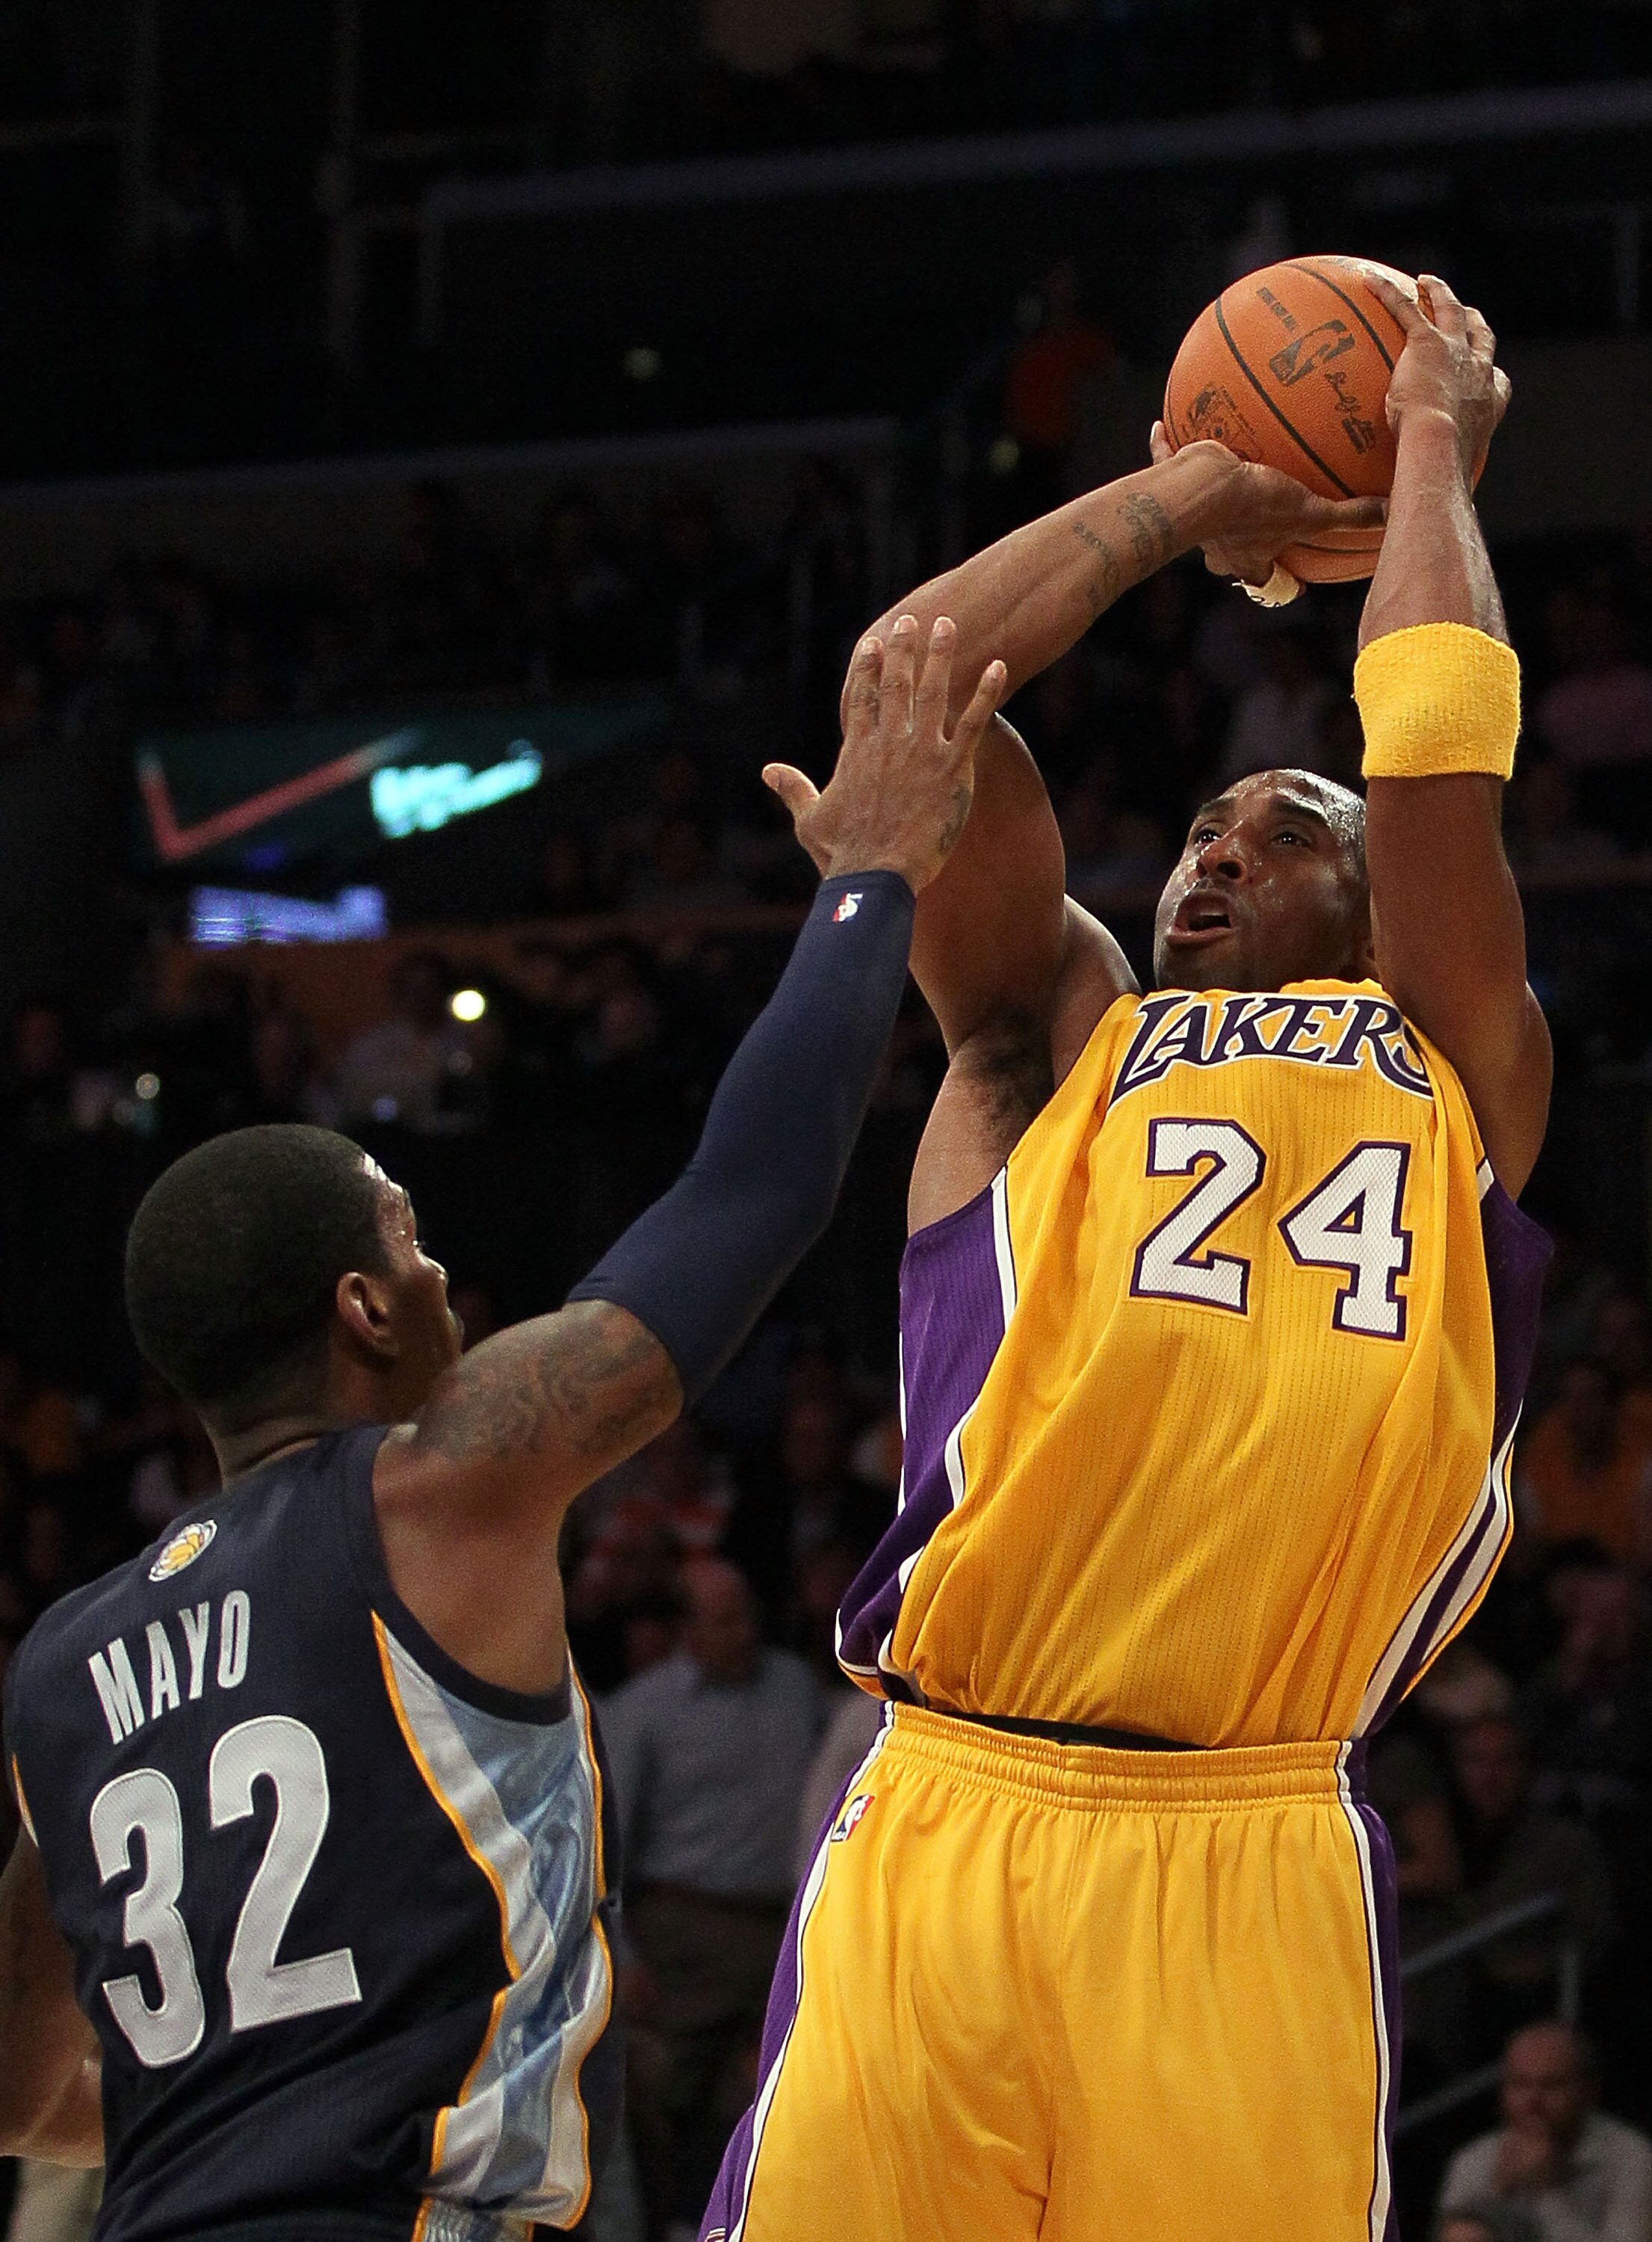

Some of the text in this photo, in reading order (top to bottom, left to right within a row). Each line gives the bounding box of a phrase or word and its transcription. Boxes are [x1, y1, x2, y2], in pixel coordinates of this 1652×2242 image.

[1107, 992, 1435, 1113] LAKERS
[1129, 1117, 1413, 1341] 24
[87, 1590, 250, 1745] MAYO
[90, 1714, 362, 2068] 32
